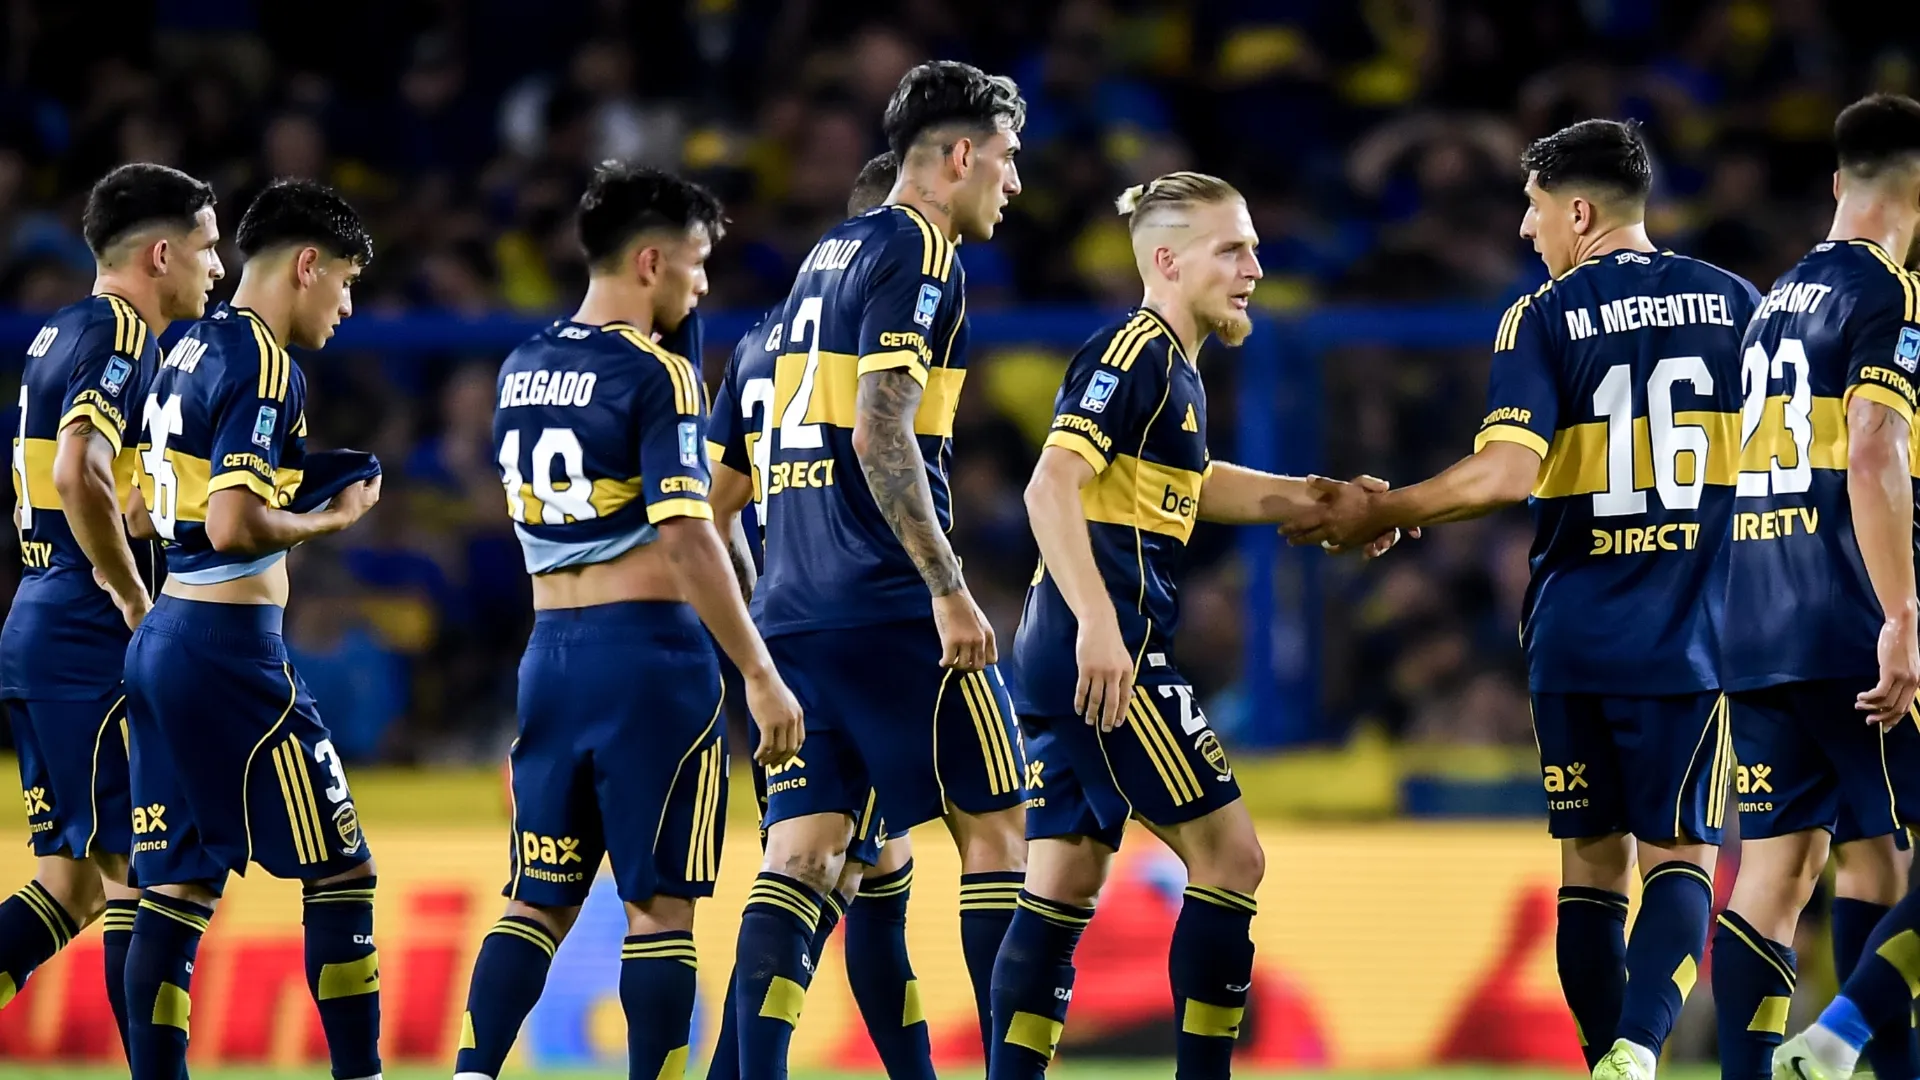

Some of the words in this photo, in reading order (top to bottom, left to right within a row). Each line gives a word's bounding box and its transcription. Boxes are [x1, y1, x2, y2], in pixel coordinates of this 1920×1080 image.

[1565, 306, 1598, 341] M.
[1601, 293, 1734, 335] MERENTIEL
[500, 369, 598, 409] DELGADO
[1860, 366, 1918, 407] CETROGA
[1592, 356, 1714, 518] 16
[1735, 338, 1814, 498] 23
[523, 831, 582, 866] pax
[524, 866, 583, 883] assistance
